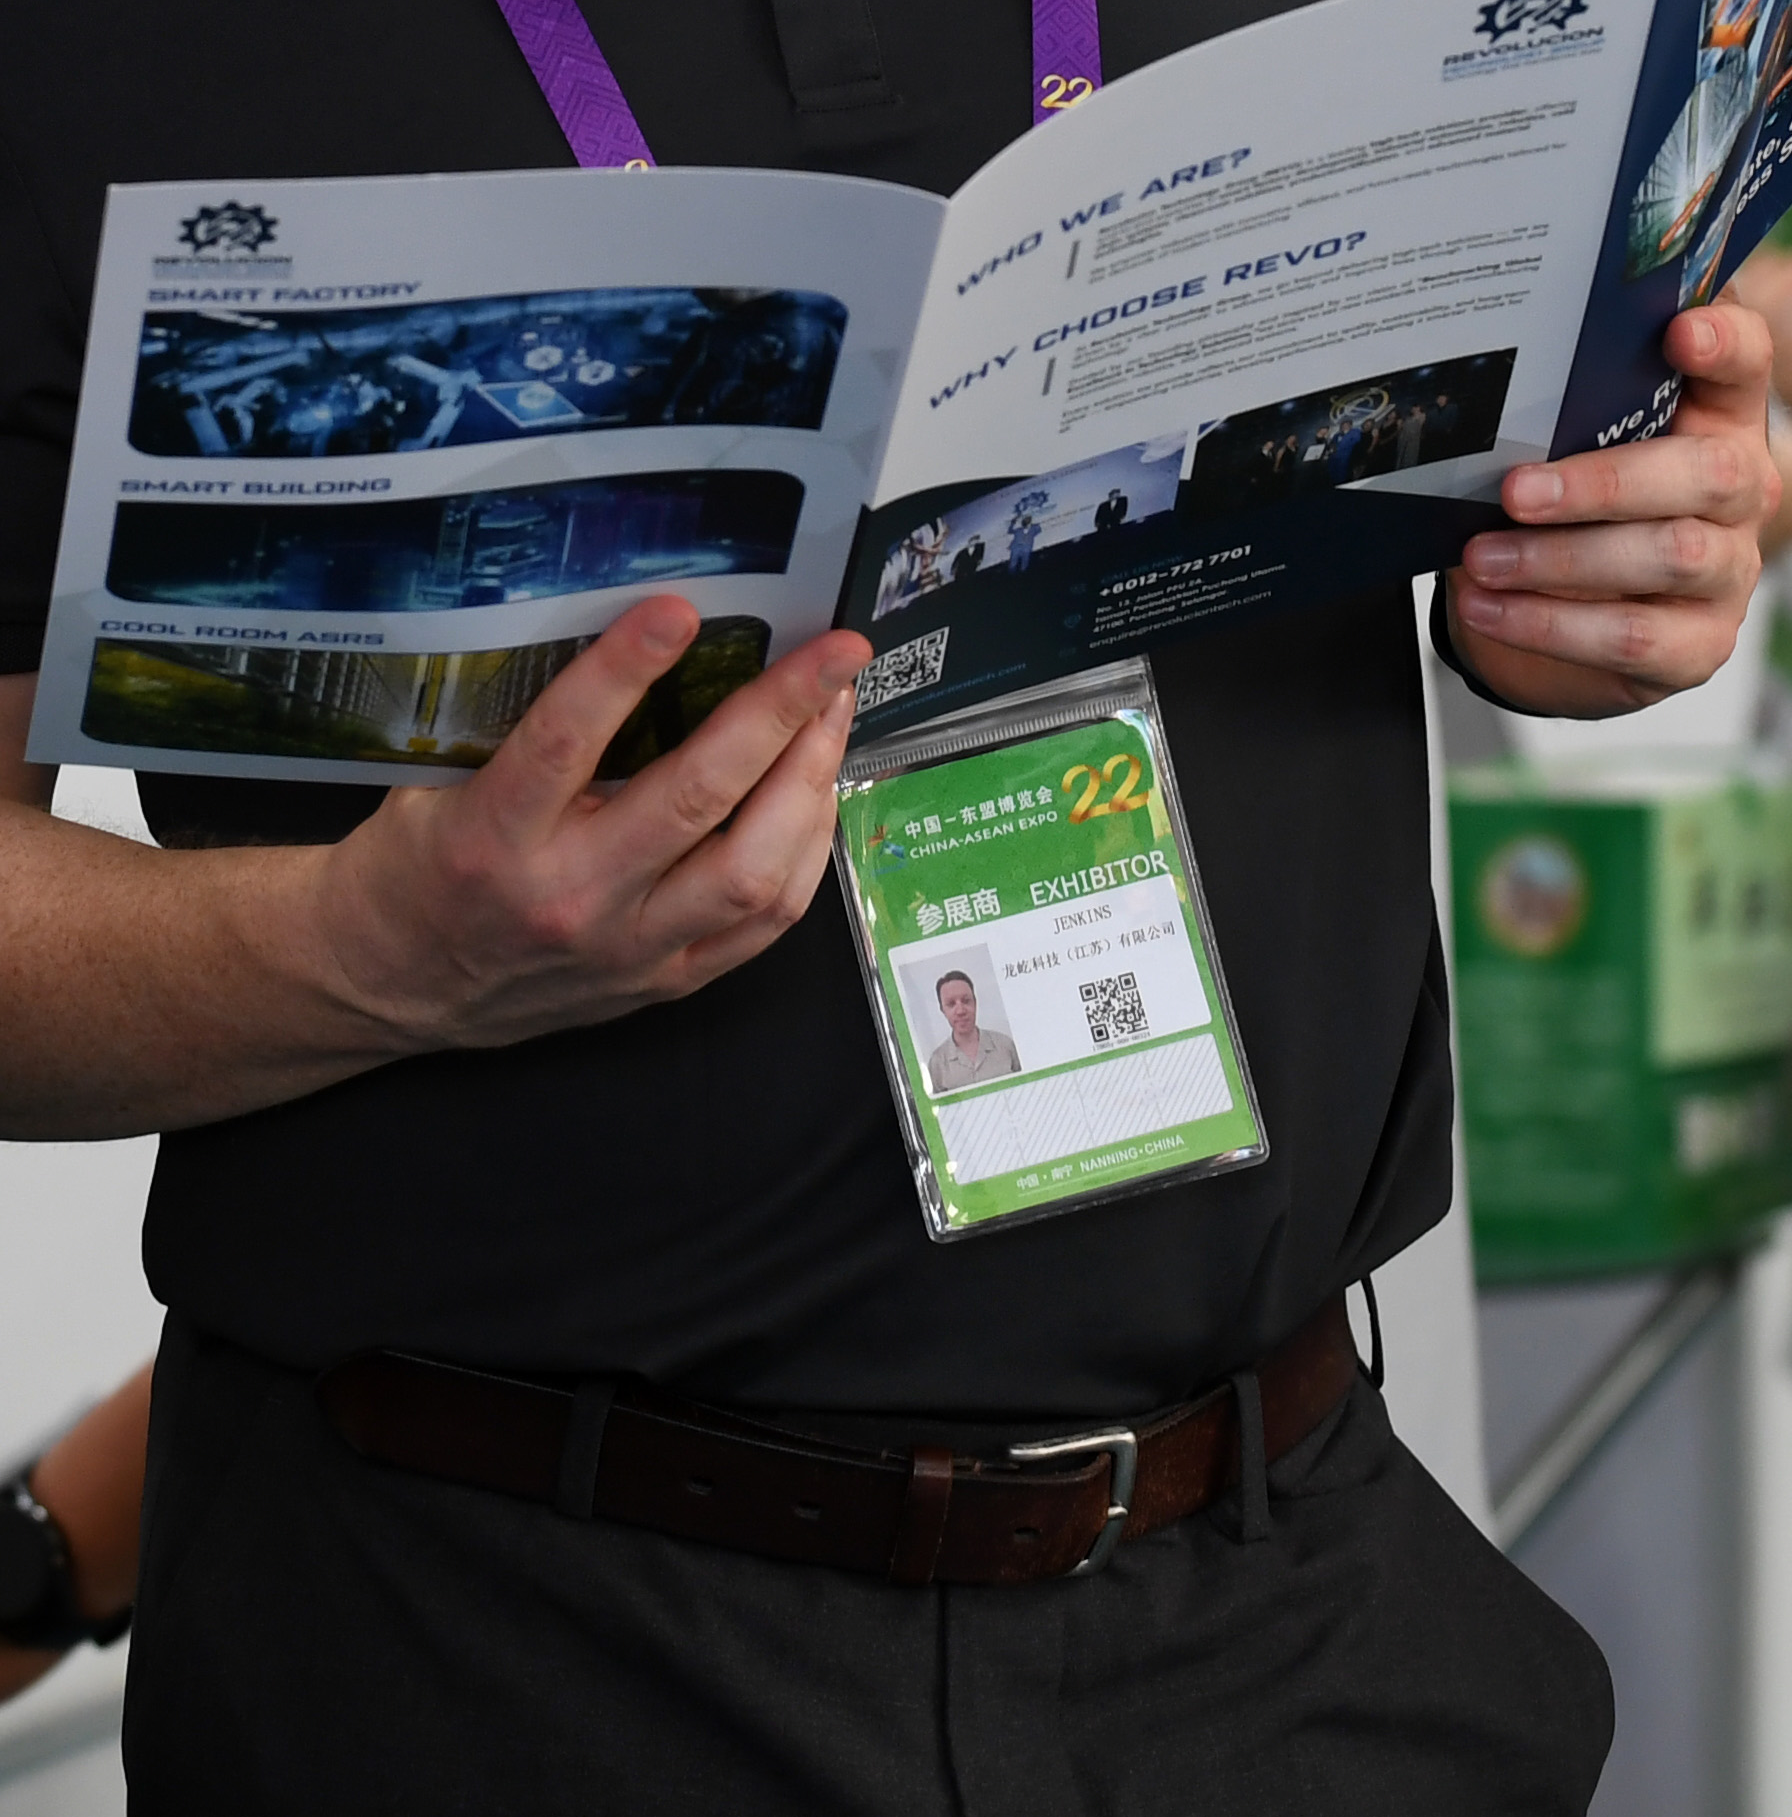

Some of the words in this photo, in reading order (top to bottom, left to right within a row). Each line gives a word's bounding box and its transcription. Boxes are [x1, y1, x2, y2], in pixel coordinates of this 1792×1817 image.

[1040, 73, 1094, 111] 22
[1735, 162, 1774, 215] ess
[957, 230, 1044, 297] WHO
[1059, 191, 1127, 235] WE
[1139, 146, 1253, 202] ARE?
[148, 287, 263, 303] SMART
[272, 280, 424, 302] FACTORY
[929, 345, 1019, 410] WHY
[1032, 273, 1209, 354] CHOOSE
[1221, 230, 1368, 287] REVO?
[1597, 409, 1645, 448] We
[120, 479, 237, 495] SMART
[242, 478, 393, 496] BUILDING
[1099, 559, 1204, 597] +6012-772
[1208, 545, 1252, 567] 7701
[100, 620, 186, 636] COOL
[195, 626, 289, 643] ROOM
[297, 631, 385, 647] ASRS
[1061, 752, 1151, 825] 22
[909, 822, 1015, 860] CHINA-ASEAN
[1018, 810, 1058, 831] EXPO
[915, 887, 1001, 936] 参展商
[1029, 849, 1171, 907] EXHIBITOR
[1052, 904, 1113, 935] JENKINS
